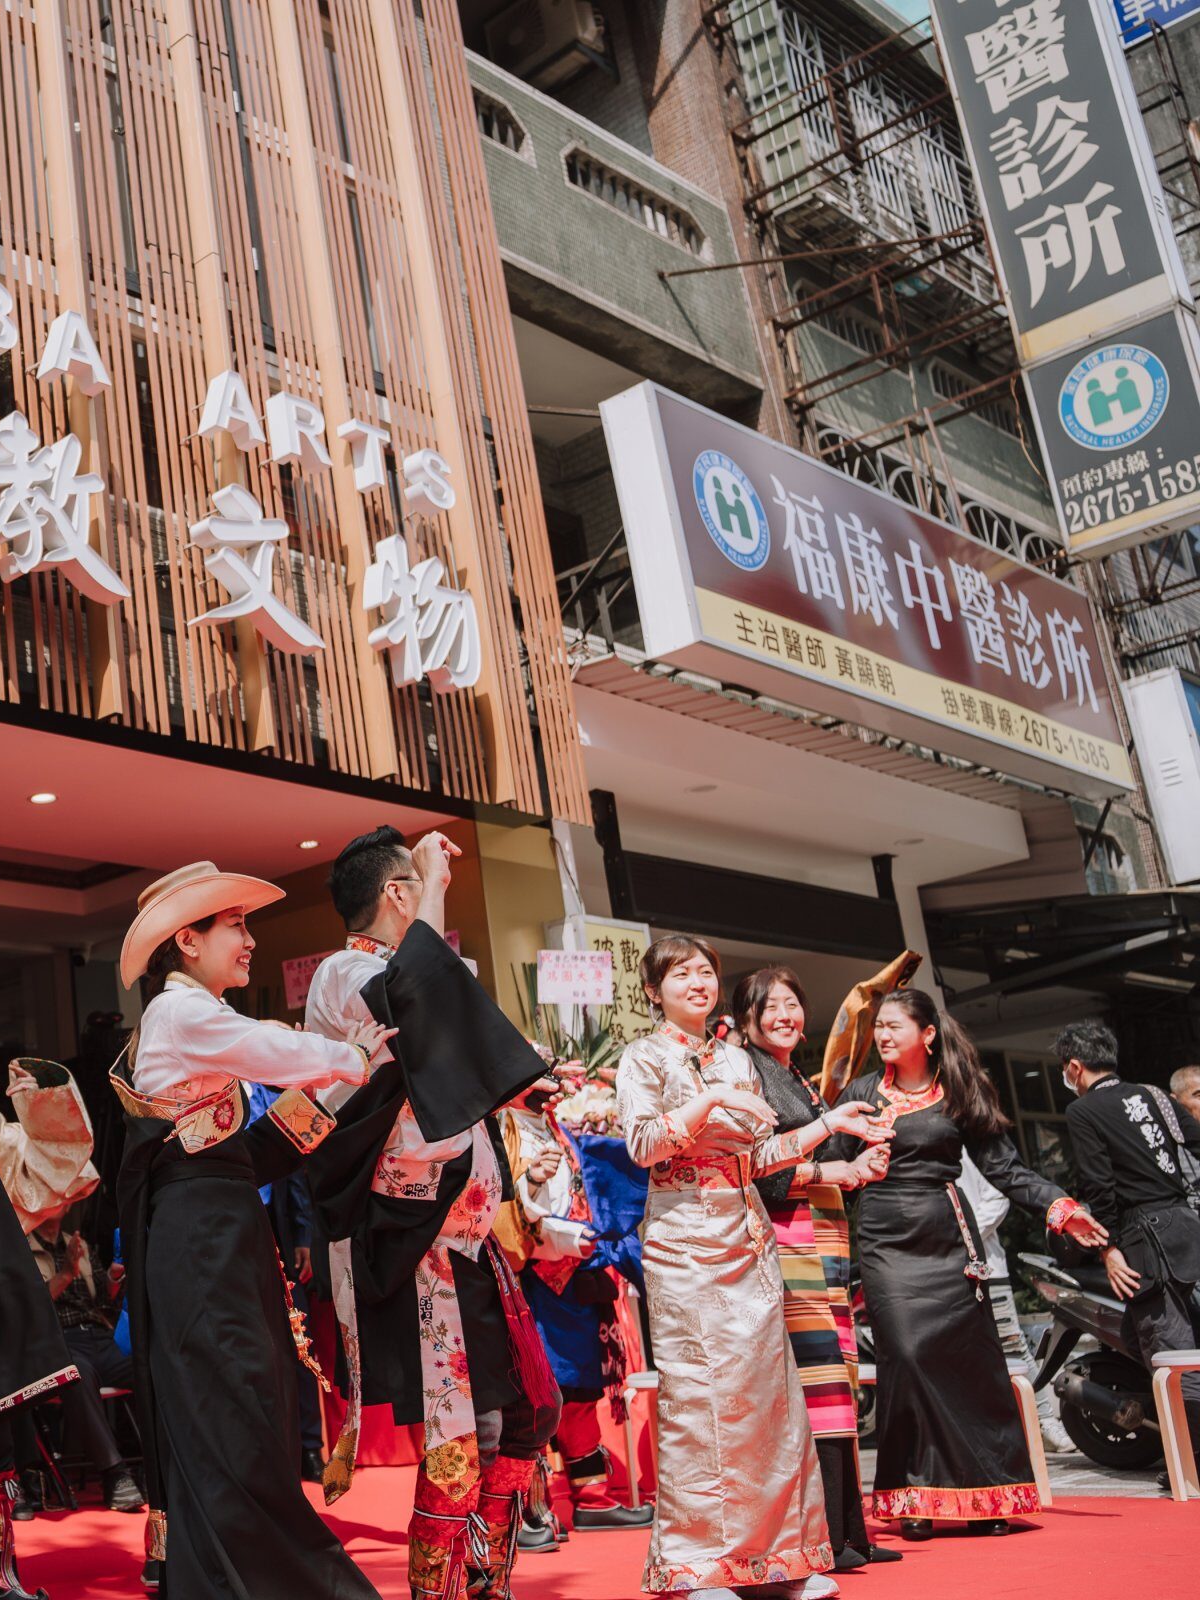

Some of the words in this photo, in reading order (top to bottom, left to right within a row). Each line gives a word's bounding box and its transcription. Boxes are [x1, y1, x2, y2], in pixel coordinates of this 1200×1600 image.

[958, 0, 1126, 309] 醫診所
[199, 370, 456, 517] ARTS
[1102, 428, 1139, 447] HEALTH
[734, 610, 827, 671] 主治醫師
[769, 473, 1100, 714] 福康中醫診所
